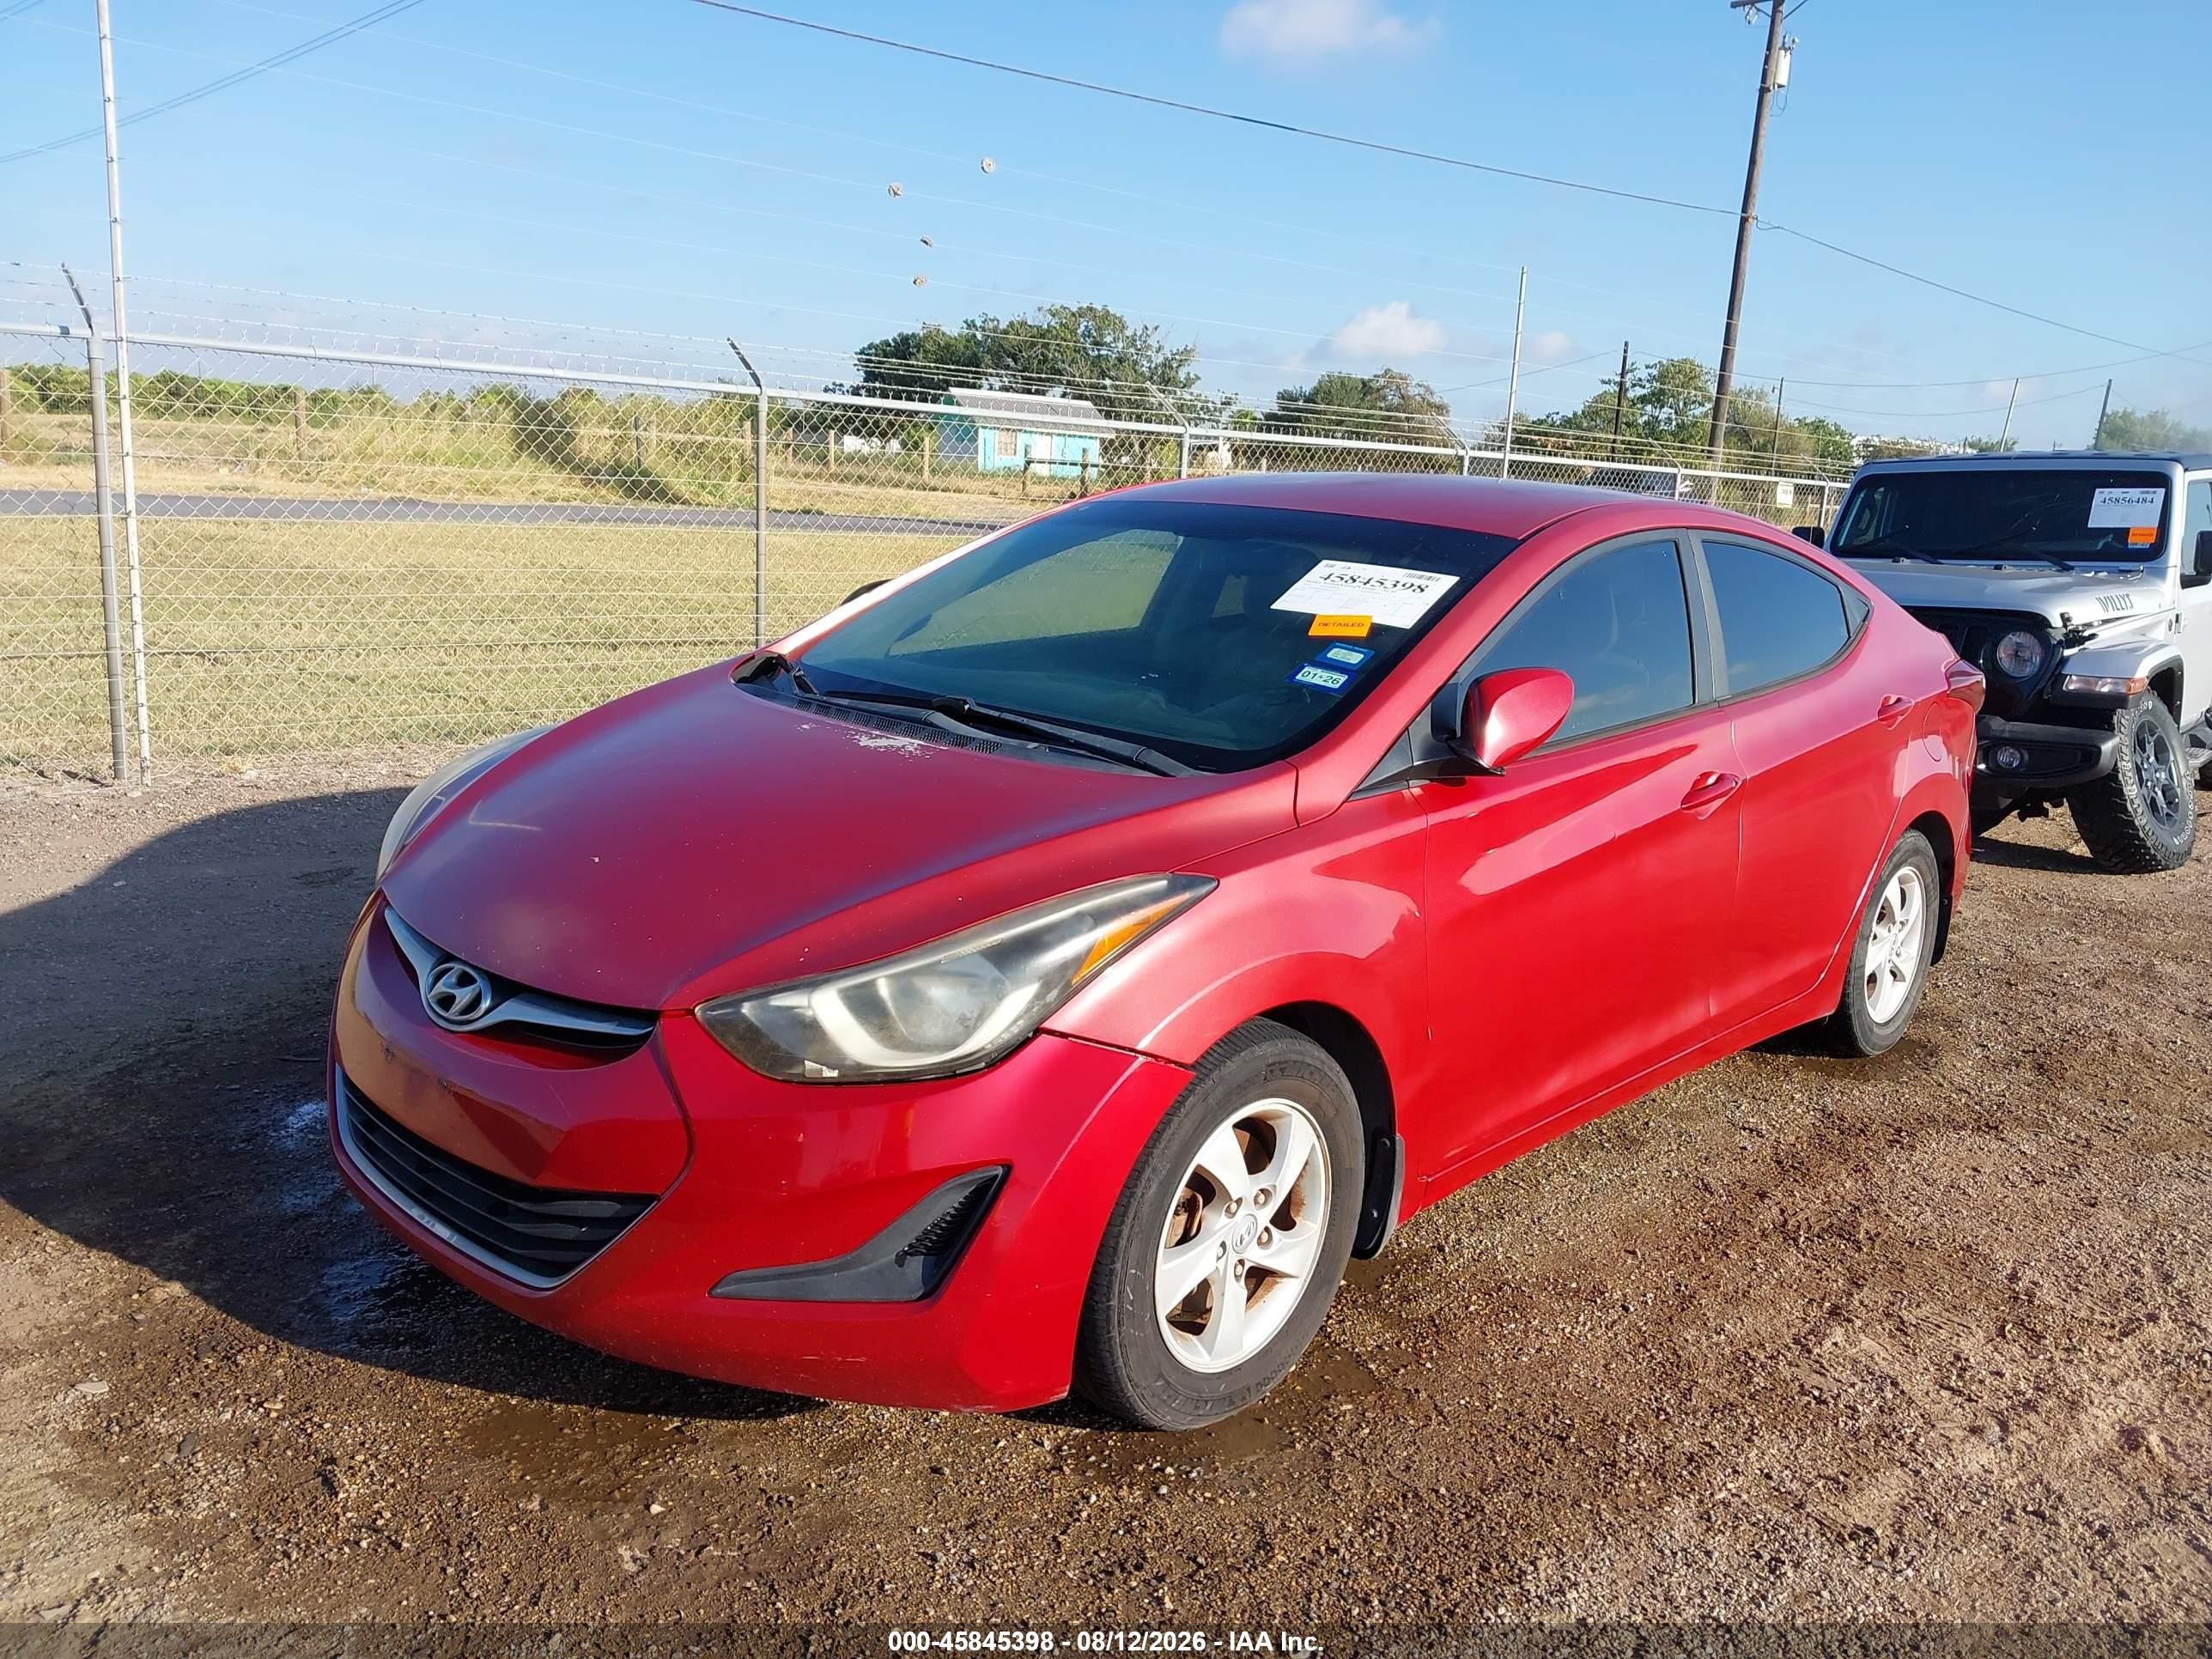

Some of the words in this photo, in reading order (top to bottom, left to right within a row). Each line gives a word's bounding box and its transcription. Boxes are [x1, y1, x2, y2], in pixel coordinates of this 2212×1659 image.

[2100, 496, 2154, 505] 45856484
[1319, 572, 1430, 594] 45845398
[2094, 592, 2134, 612] WILLYS
